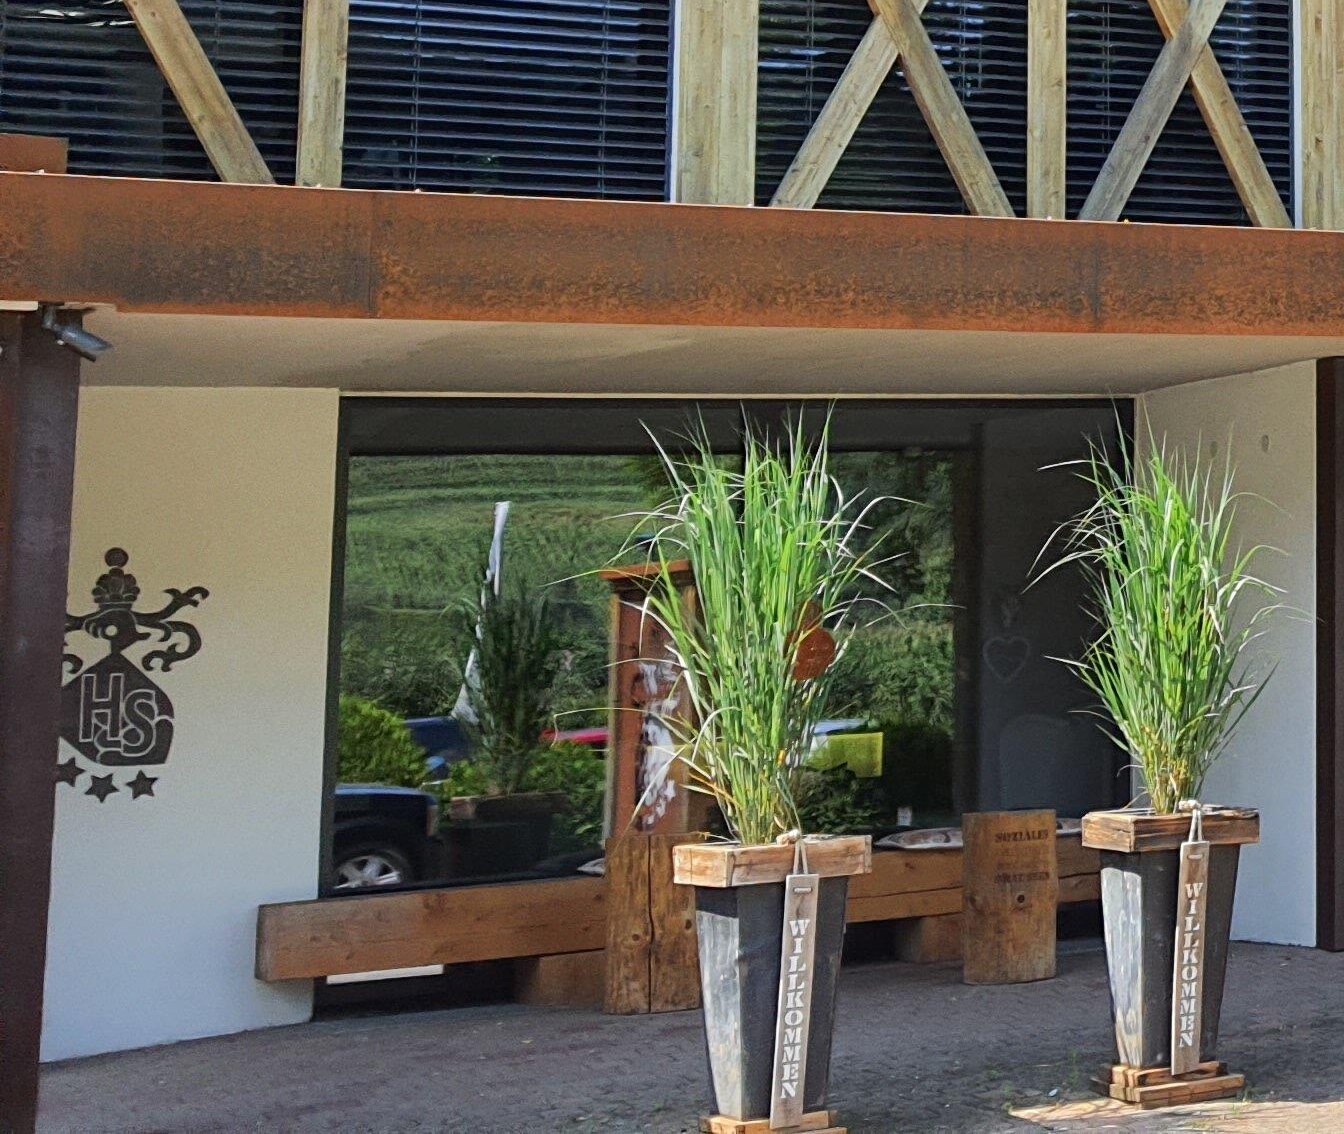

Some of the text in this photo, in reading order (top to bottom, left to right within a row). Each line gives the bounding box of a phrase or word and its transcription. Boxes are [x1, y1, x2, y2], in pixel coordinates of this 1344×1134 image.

[79, 673, 158, 757] HS
[780, 918, 811, 1099] WILLKOMMEN
[1178, 882, 1204, 1048] WILLKOMMEN
